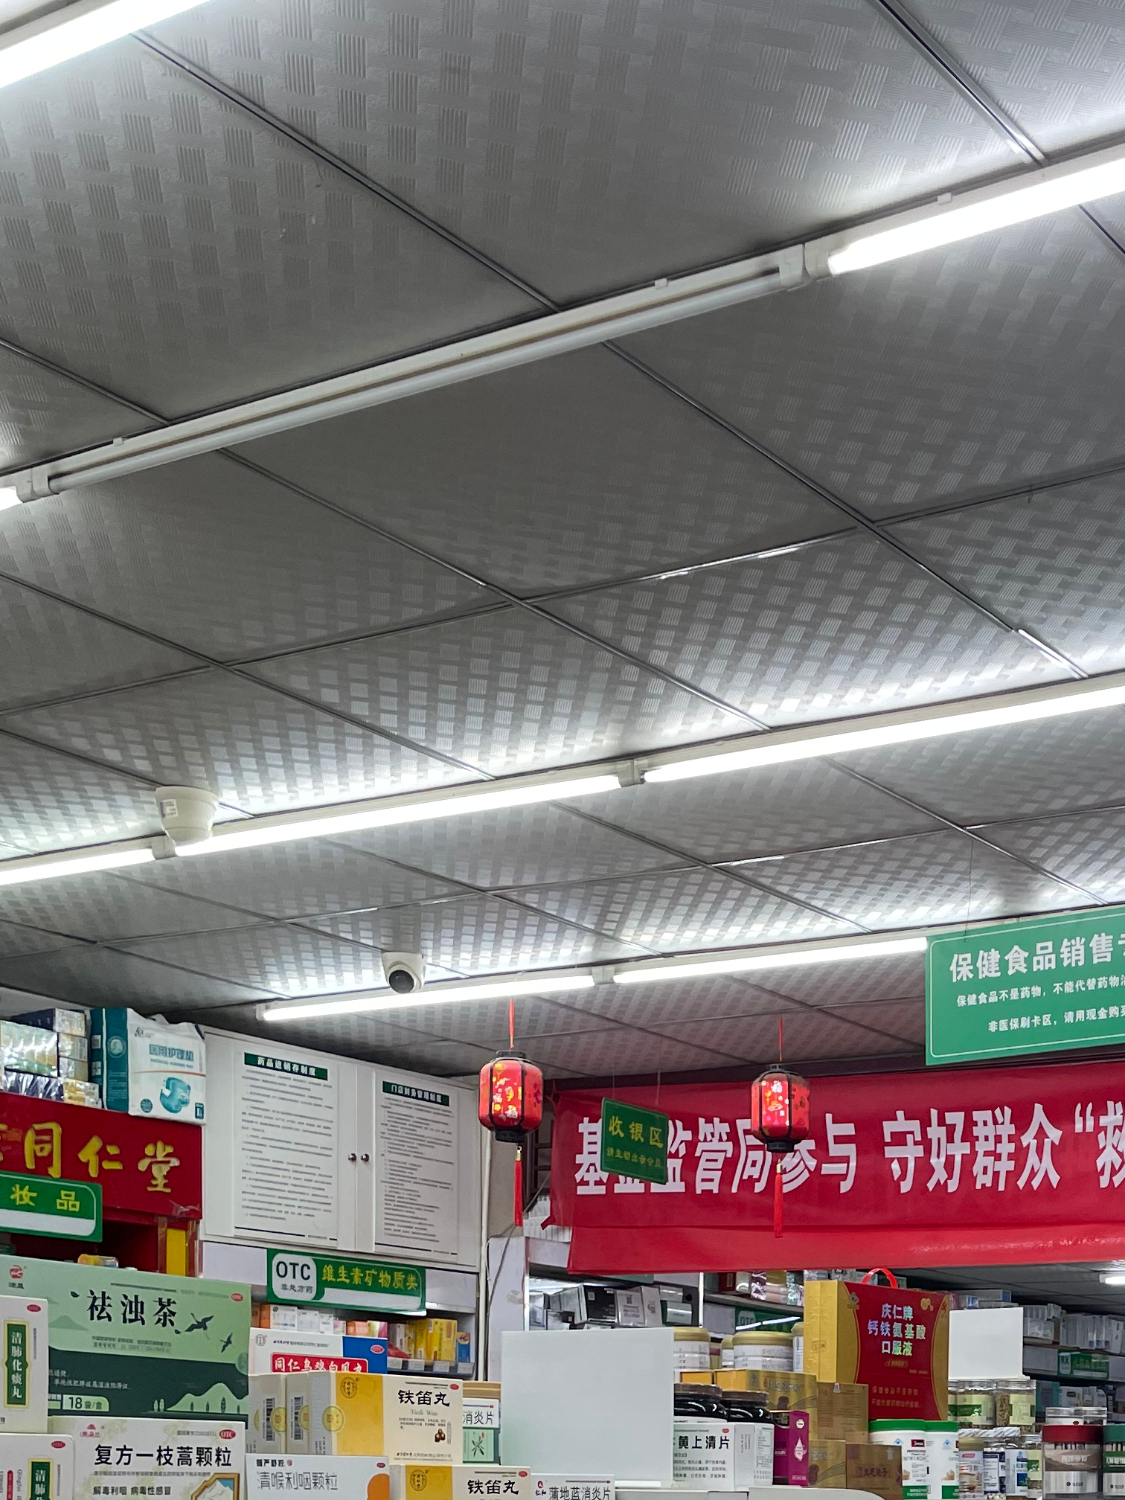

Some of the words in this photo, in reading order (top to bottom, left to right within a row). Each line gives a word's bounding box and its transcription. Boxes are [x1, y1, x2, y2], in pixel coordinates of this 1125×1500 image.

[257, 1056, 317, 1077] 药品进销存制度
[608, 1114, 664, 1149] 收银区
[10, 1183, 80, 1213] 妆品
[275, 1260, 311, 1281] OTC
[322, 1264, 419, 1291] 维生素矿物质类
[87, 1289, 178, 1328] 祛浊茶
[881, 1303, 914, 1321] 庆仁牌
[867, 1319, 926, 1340] 钙铁氨基酸
[881, 1340, 913, 1357] 口服液
[10, 1331, 23, 1399] 清肺化痰丸
[397, 1389, 451, 1407] 铁笛丸
[462, 1410, 494, 1425] 消炎片
[673, 1435, 730, 1450] 黄上清片
[93, 1444, 233, 1468] 复方一枝蒿颗粒
[256, 1471, 339, 1491] 清喉利咽颗粒
[467, 1478, 519, 1496] 铁笛丸
